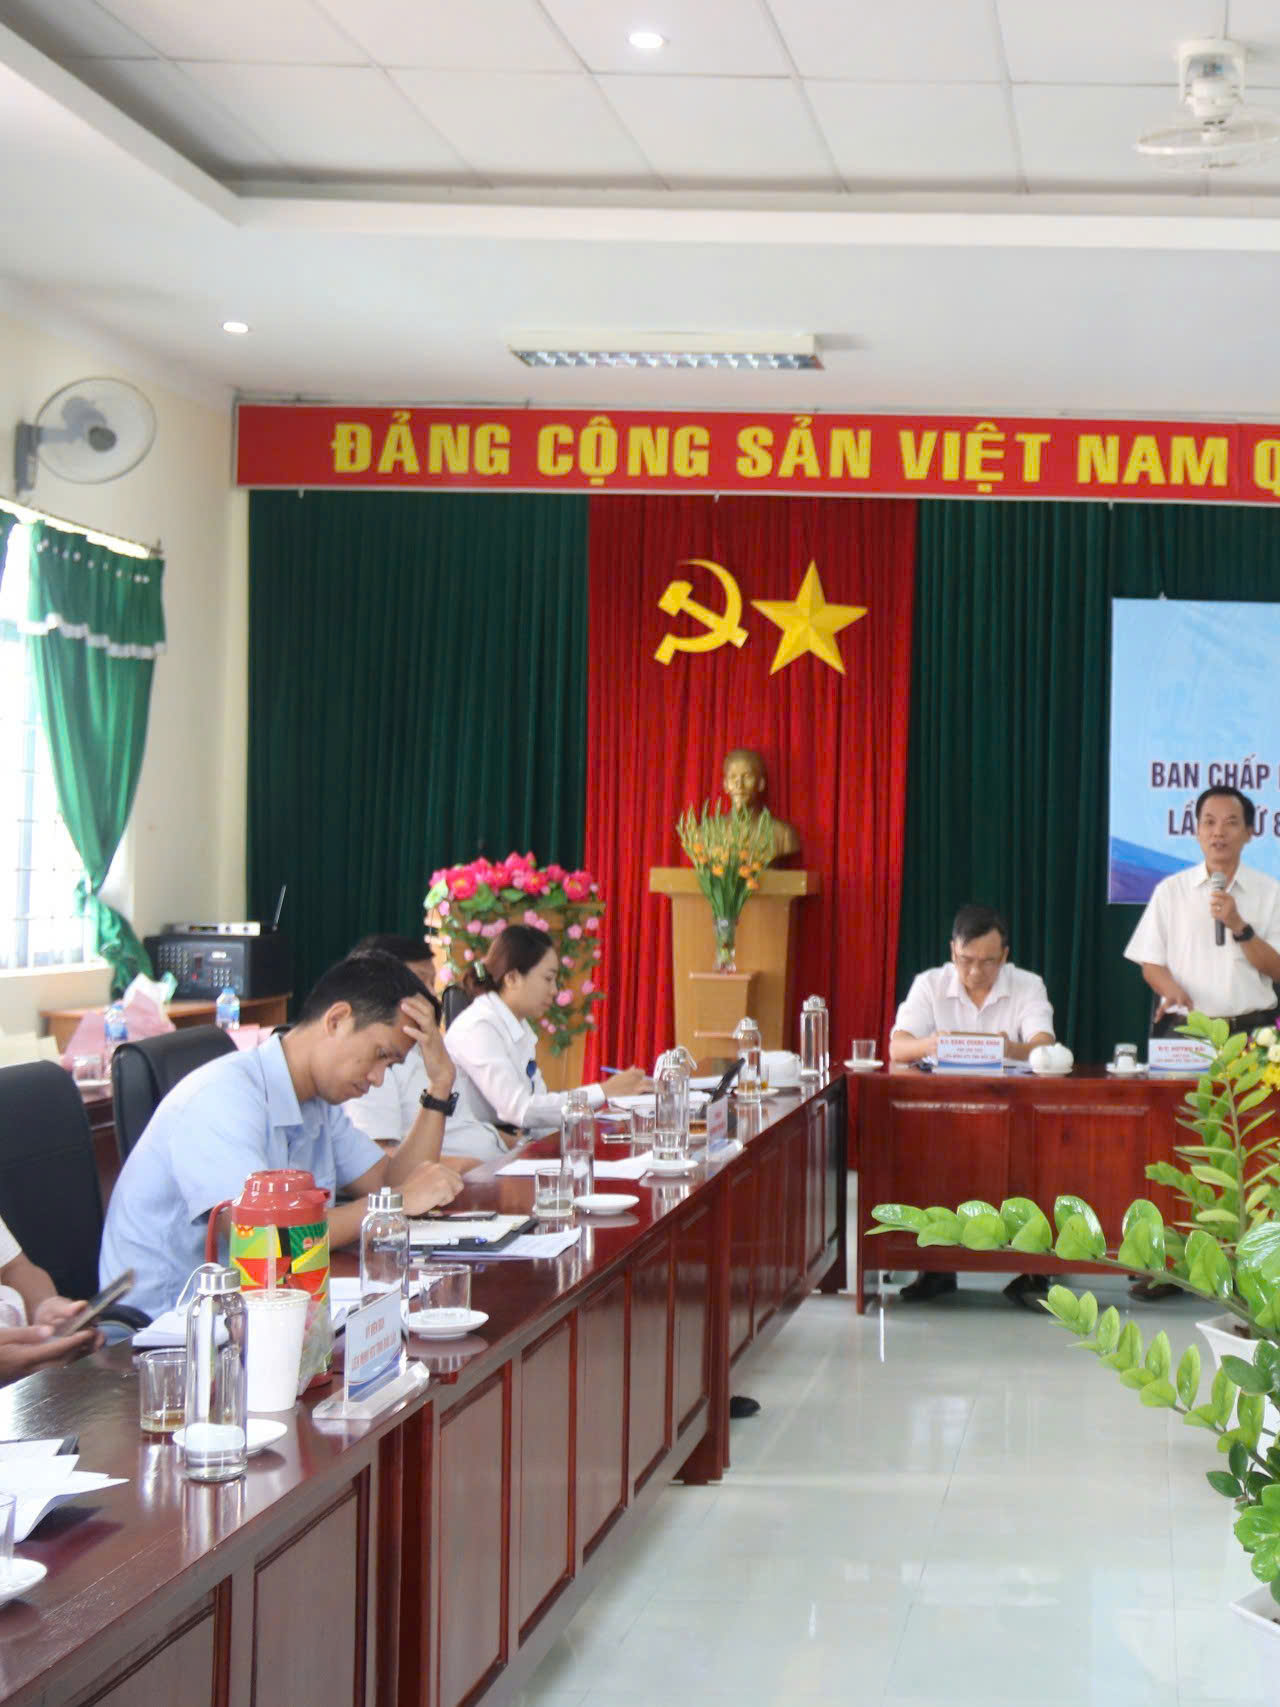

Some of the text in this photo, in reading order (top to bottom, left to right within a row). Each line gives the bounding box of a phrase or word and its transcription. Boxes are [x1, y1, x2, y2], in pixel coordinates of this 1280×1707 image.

[331, 411, 511, 475] ĐẢNG
[537, 416, 710, 486] CỘNG
[736, 416, 872, 479] SẢN
[899, 422, 1051, 492] VIỆT
[1077, 434, 1229, 487] NAM
[1151, 762, 1200, 788] BAN
[1208, 754, 1270, 789] CHẤP
[1168, 800, 1197, 836] LẦ
